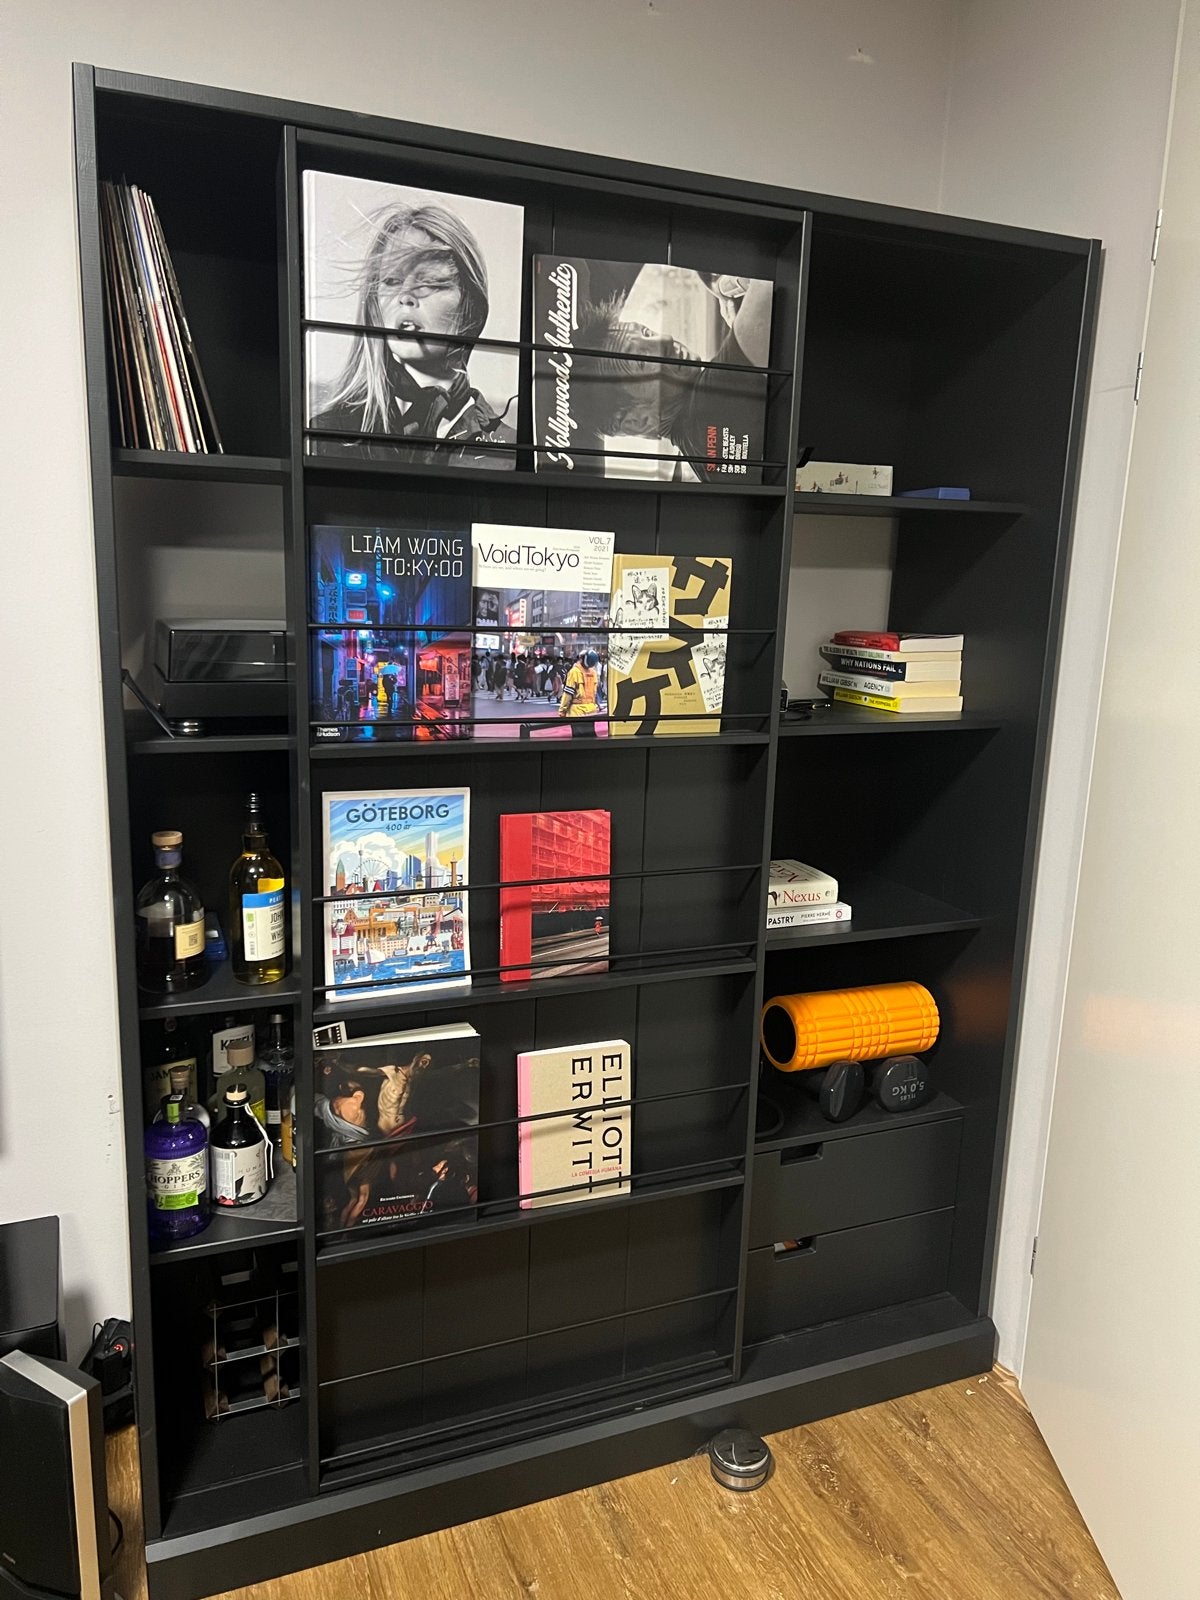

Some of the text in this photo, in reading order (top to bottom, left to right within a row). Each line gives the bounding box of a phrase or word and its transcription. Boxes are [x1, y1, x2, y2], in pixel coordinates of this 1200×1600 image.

[544, 264, 579, 470] Hollywood Authentic
[707, 426, 717, 448] PENN
[351, 535, 464, 557] LIAM WONG
[840, 658, 897, 672] WHY NATIONS FAIL
[863, 681, 885, 692] AGENCY
[345, 803, 450, 823] GÖTEBORG
[385, 822, 402, 832] 400
[783, 890, 821, 904] Nexus
[768, 915, 795, 926] PASTRY
[892, 1084, 907, 1096] KG
